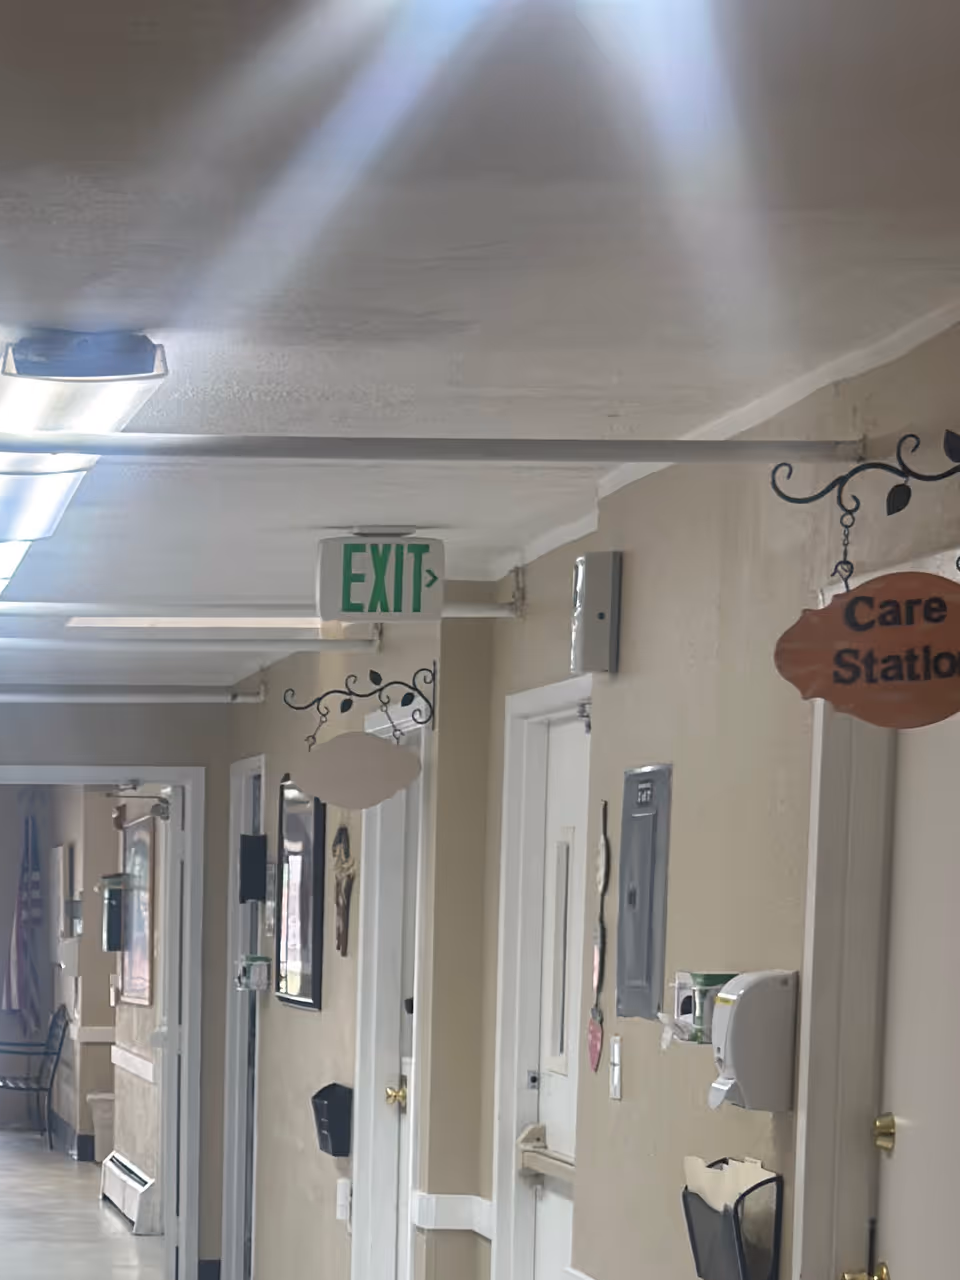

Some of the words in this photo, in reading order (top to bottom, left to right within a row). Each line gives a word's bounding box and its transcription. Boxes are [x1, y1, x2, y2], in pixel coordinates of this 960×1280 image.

[341, 543, 430, 613] EXIT
[844, 596, 948, 632] Care
[833, 646, 960, 685] Statio
